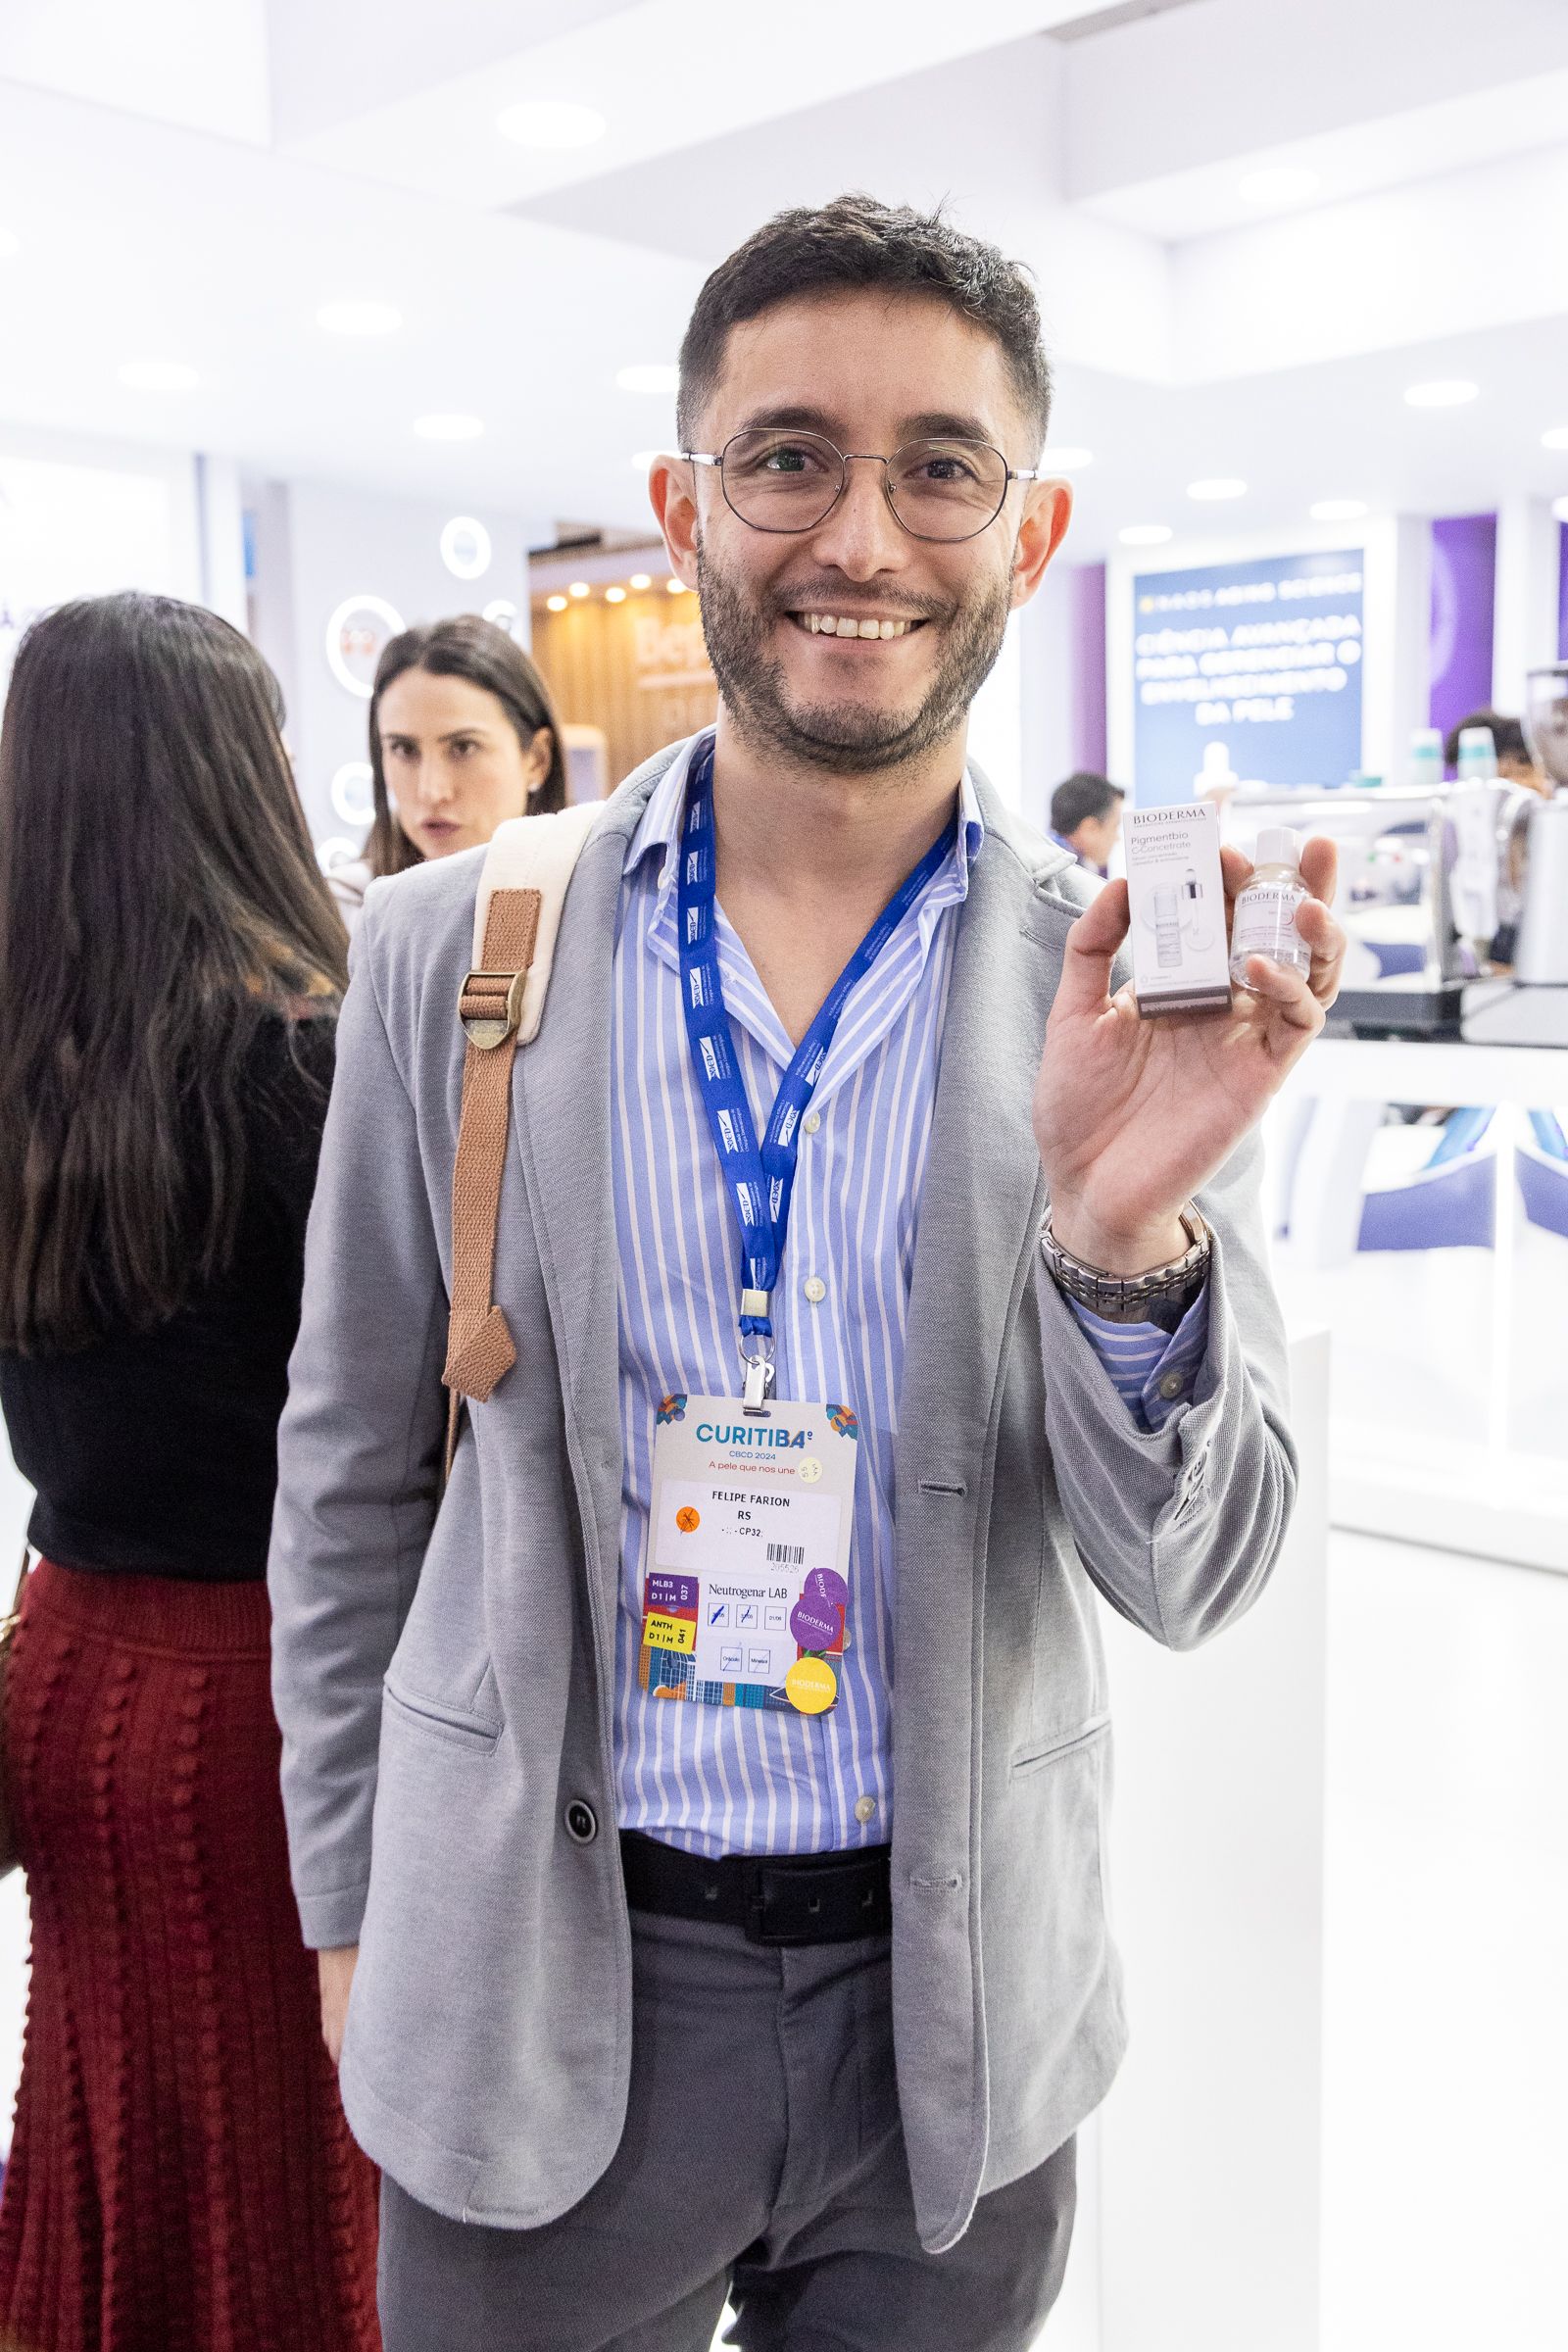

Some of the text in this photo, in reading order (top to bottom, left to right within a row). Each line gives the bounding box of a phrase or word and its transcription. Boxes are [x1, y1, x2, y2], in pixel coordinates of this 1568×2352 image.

[1133, 808, 1205, 824] BIODERMA
[1131, 832, 1189, 846] Pigmentbio
[1242, 892, 1296, 905] BIODERMA
[717, 1462, 737, 1472] pele
[739, 1464, 757, 1473] que
[711, 1491, 790, 1507] FELIPE FARION
[738, 1510, 752, 1520] RS
[768, 1587, 788, 1598] LAB
[651, 1620, 673, 1630] ANTH
[797, 1611, 834, 1632] BIODERMA
[677, 1629, 686, 1643] 041
[791, 1679, 831, 1690] BIODERMA
